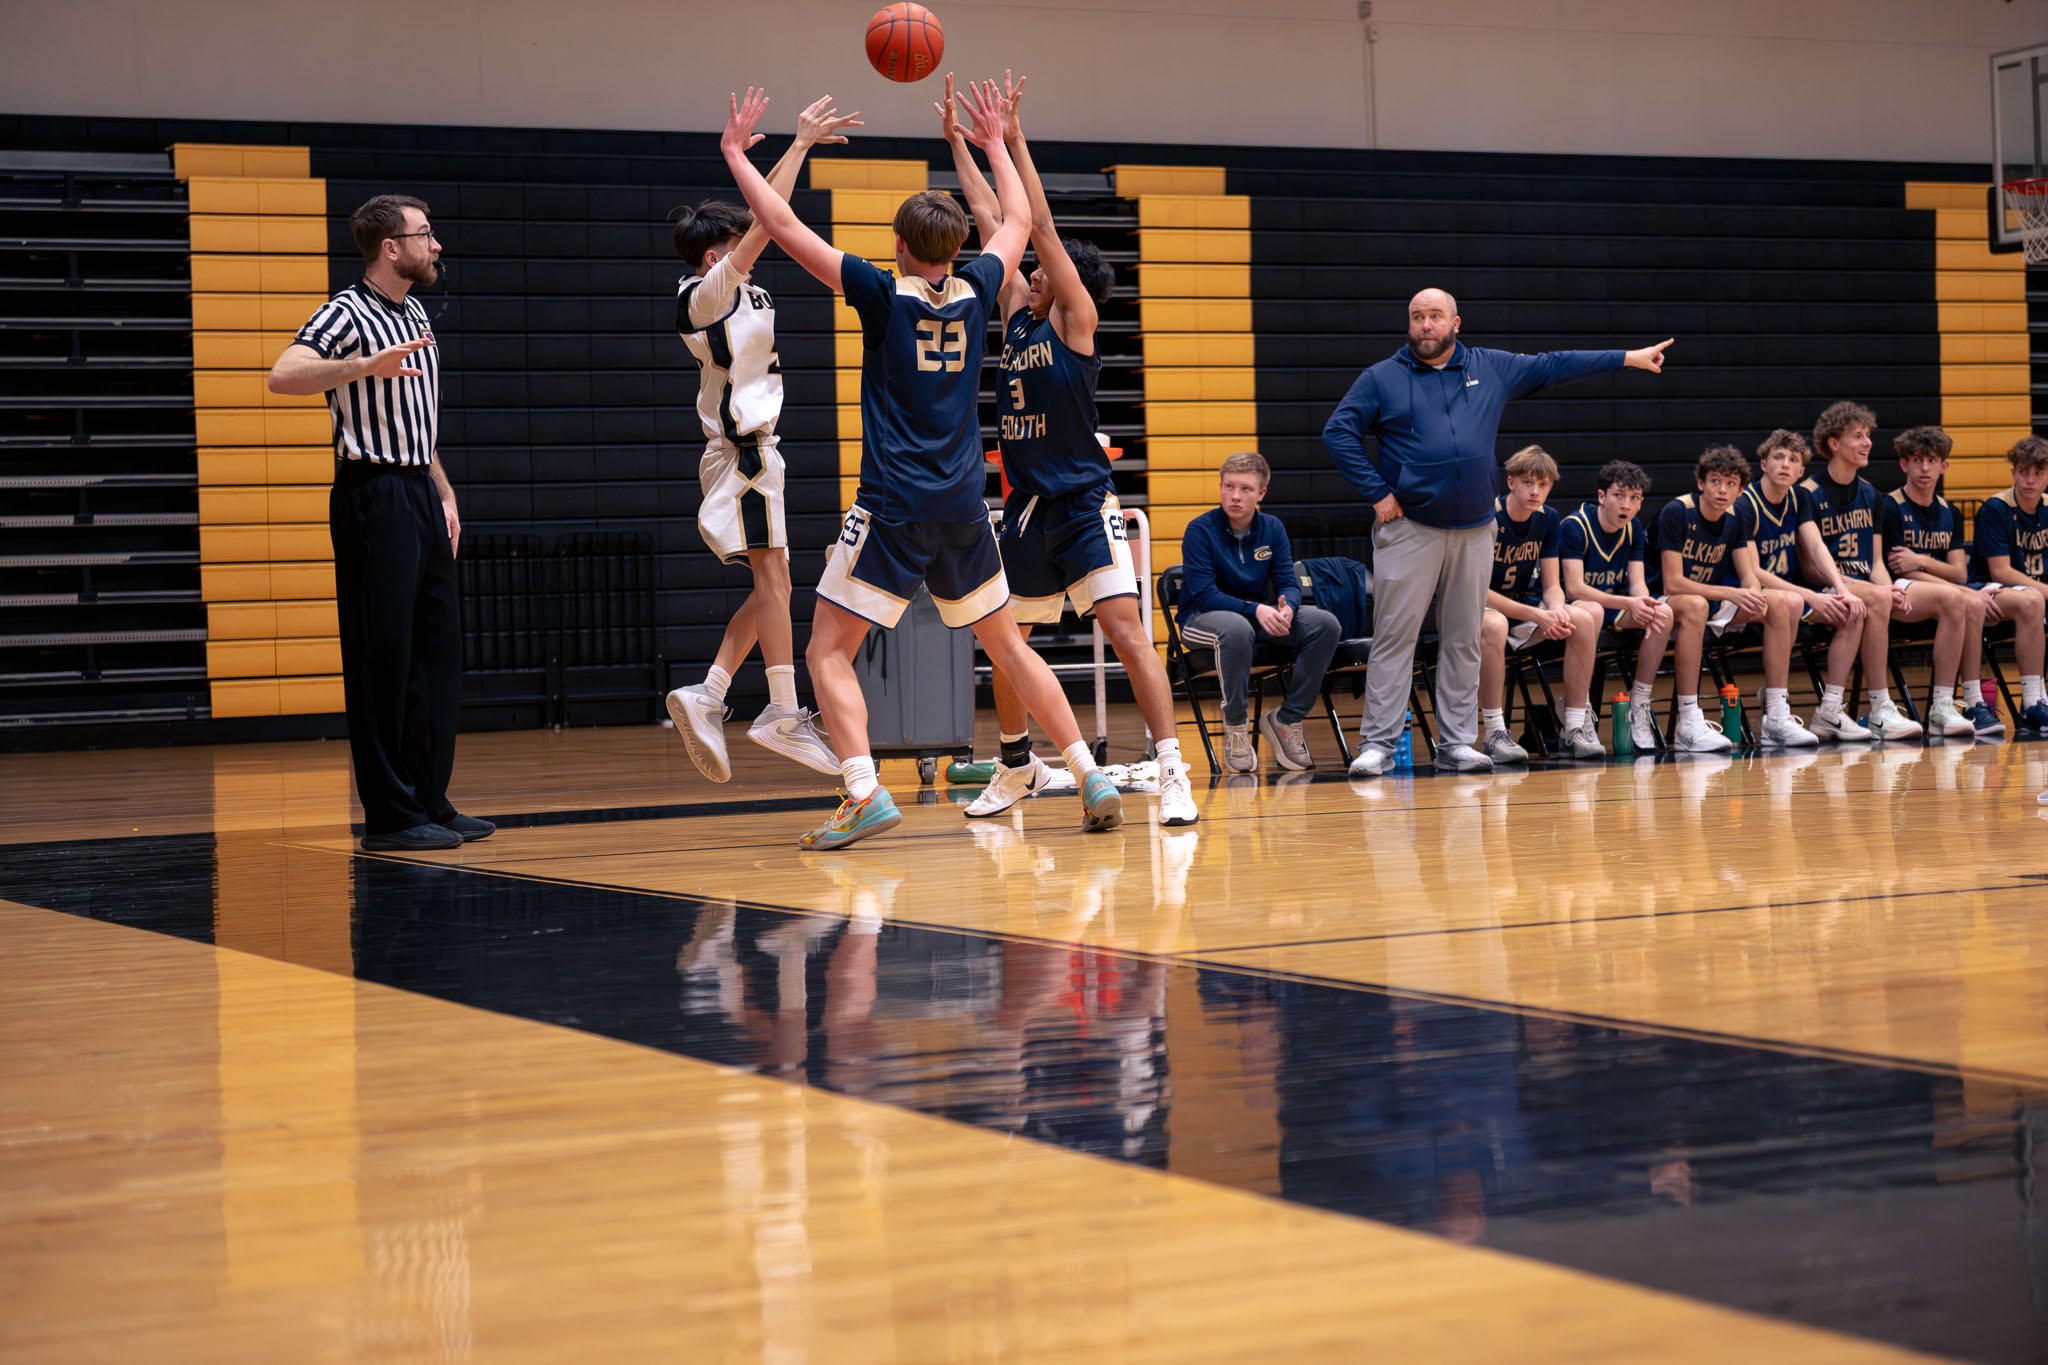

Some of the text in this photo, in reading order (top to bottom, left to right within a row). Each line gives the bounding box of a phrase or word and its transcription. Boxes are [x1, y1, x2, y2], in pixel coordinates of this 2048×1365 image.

[916, 319, 967, 373] 23
[1000, 340, 1053, 373] ELORN
[1008, 377, 1026, 411] 3
[1001, 413, 1047, 441] SOUTH
[1838, 532, 1859, 558] 35
[1501, 565, 1518, 590] 5
[1836, 560, 1872, 576] OUTH
